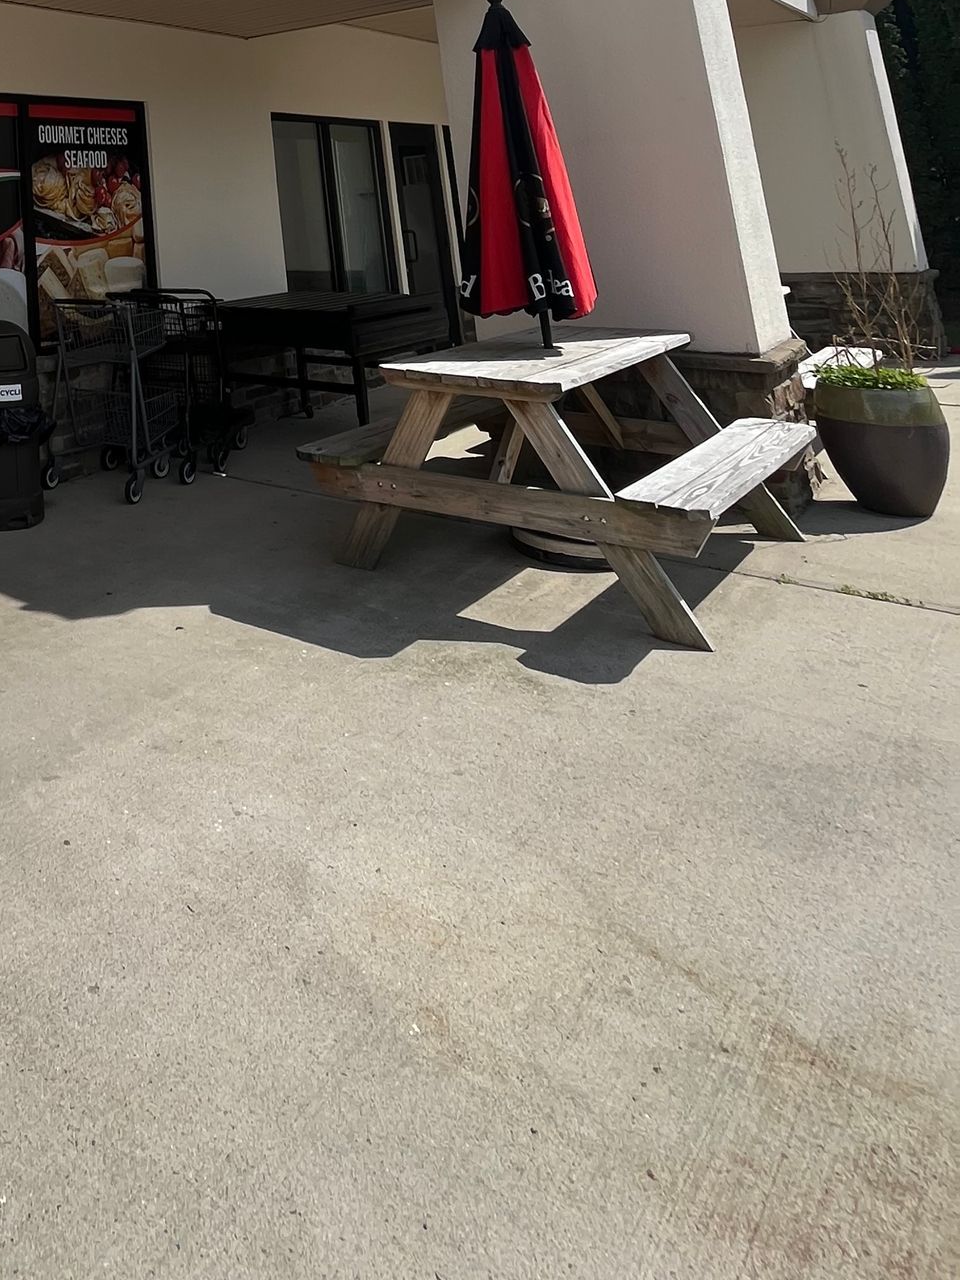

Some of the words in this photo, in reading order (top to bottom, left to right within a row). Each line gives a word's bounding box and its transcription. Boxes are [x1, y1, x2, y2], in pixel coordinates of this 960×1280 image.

[38, 124, 85, 145] GOURMET
[87, 126, 128, 146] CHEESES
[64, 150, 108, 169] SEAFOOD
